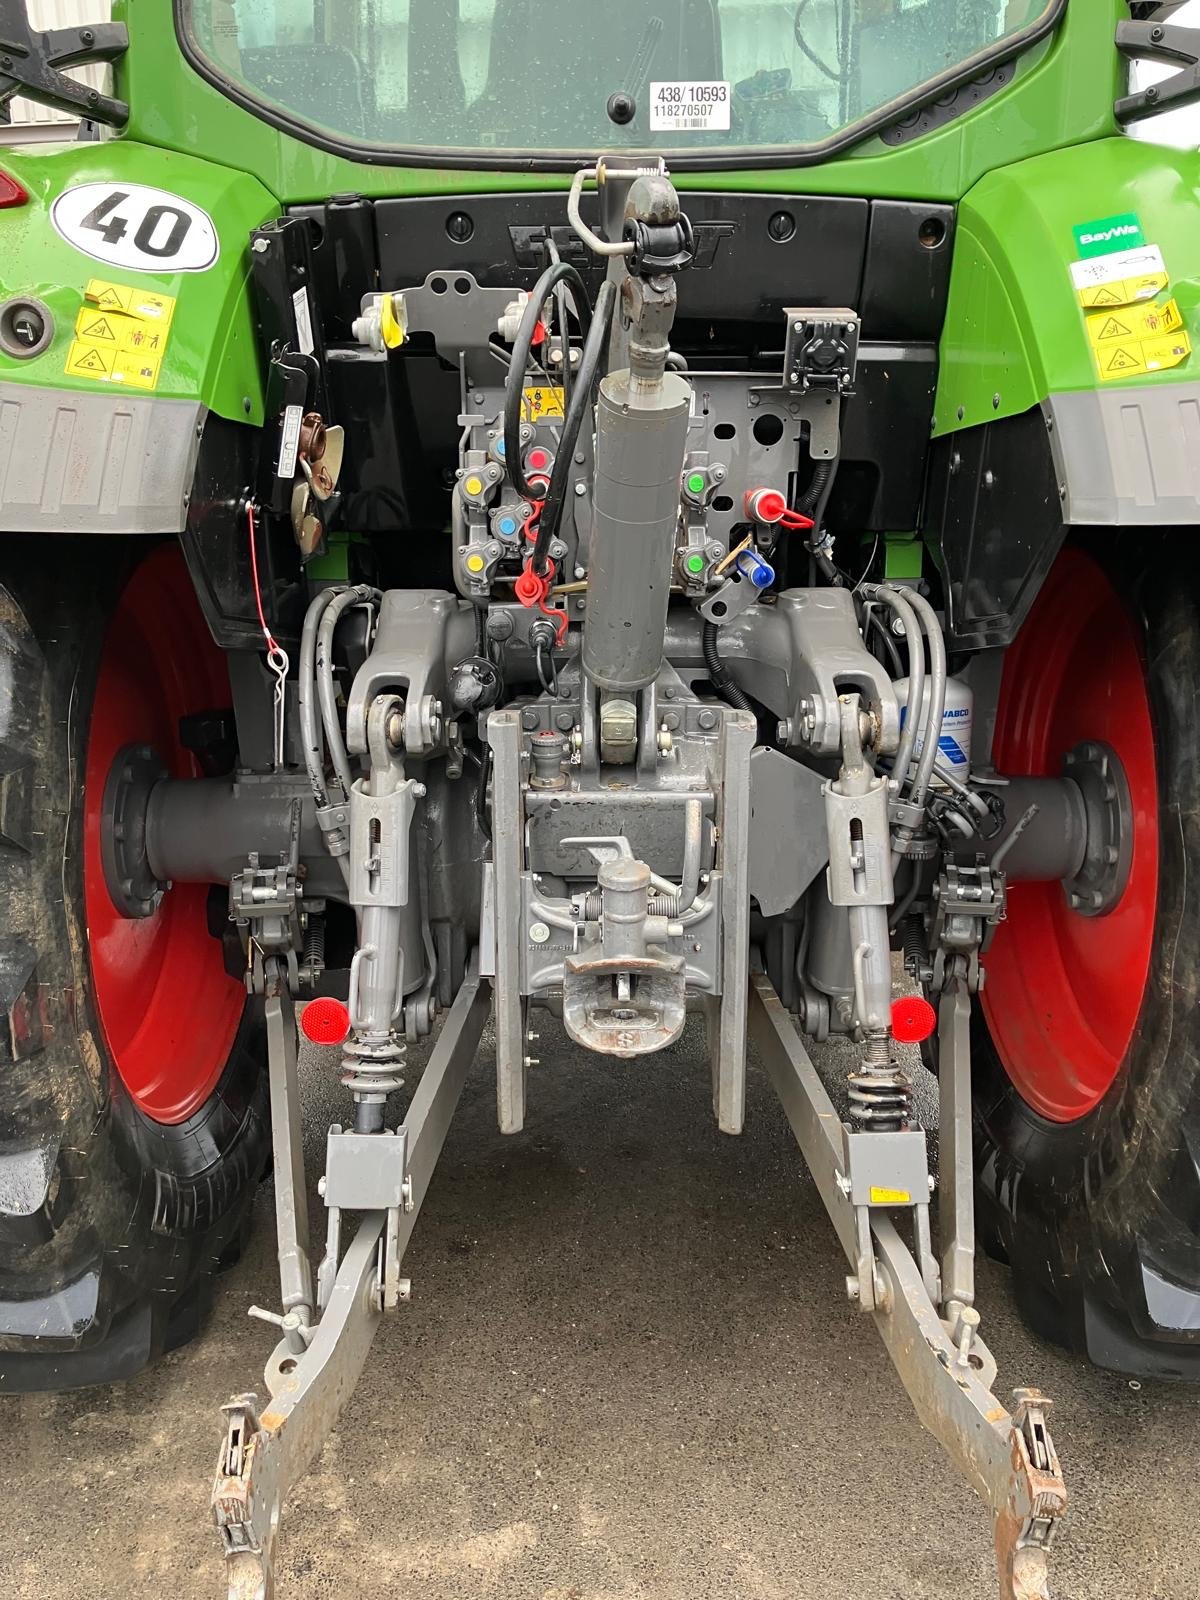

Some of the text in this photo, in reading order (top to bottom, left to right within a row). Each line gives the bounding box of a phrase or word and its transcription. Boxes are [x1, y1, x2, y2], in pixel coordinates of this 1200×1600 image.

[654, 104, 713, 117] 118270507
[79, 191, 193, 258] 40
[1079, 224, 1139, 245] BayWa
